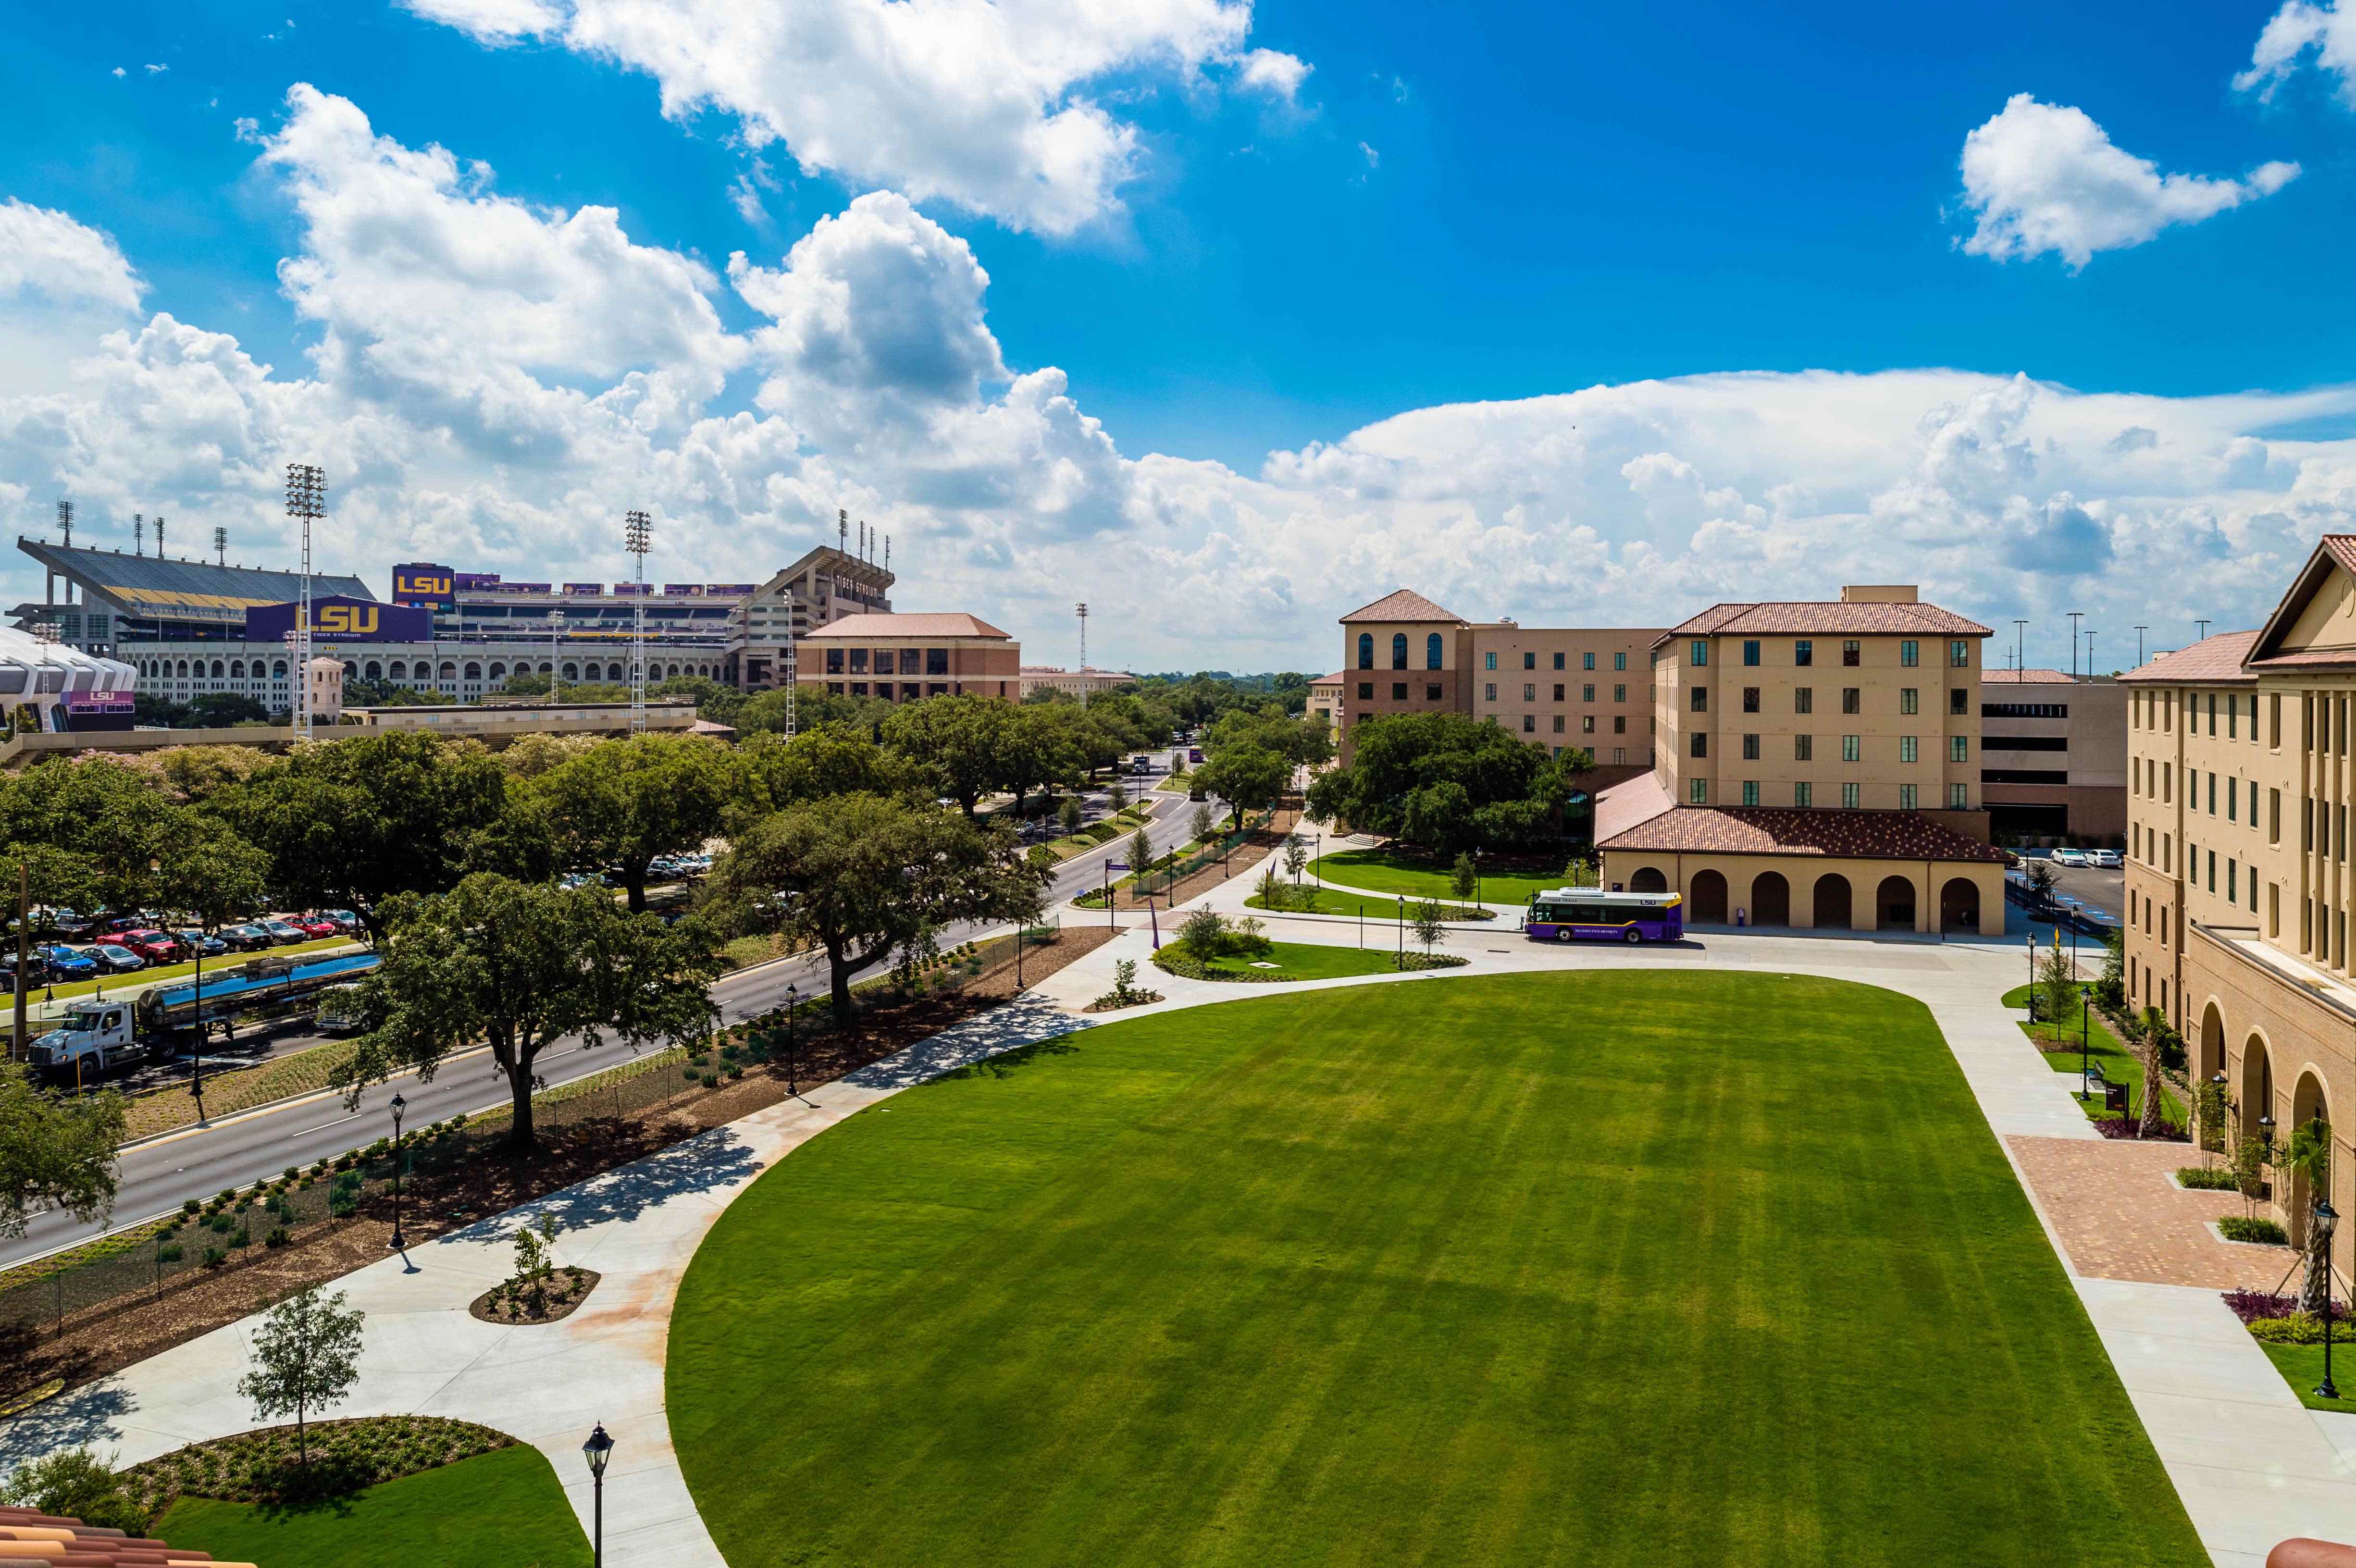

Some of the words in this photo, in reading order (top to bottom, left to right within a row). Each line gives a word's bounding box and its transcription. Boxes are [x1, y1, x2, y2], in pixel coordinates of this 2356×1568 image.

[398, 576, 450, 594] LSU
[837, 575, 853, 590] TIGER
[856, 582, 877, 598] STADIUM
[295, 605, 378, 633] LSU
[90, 692, 115, 701] LSU
